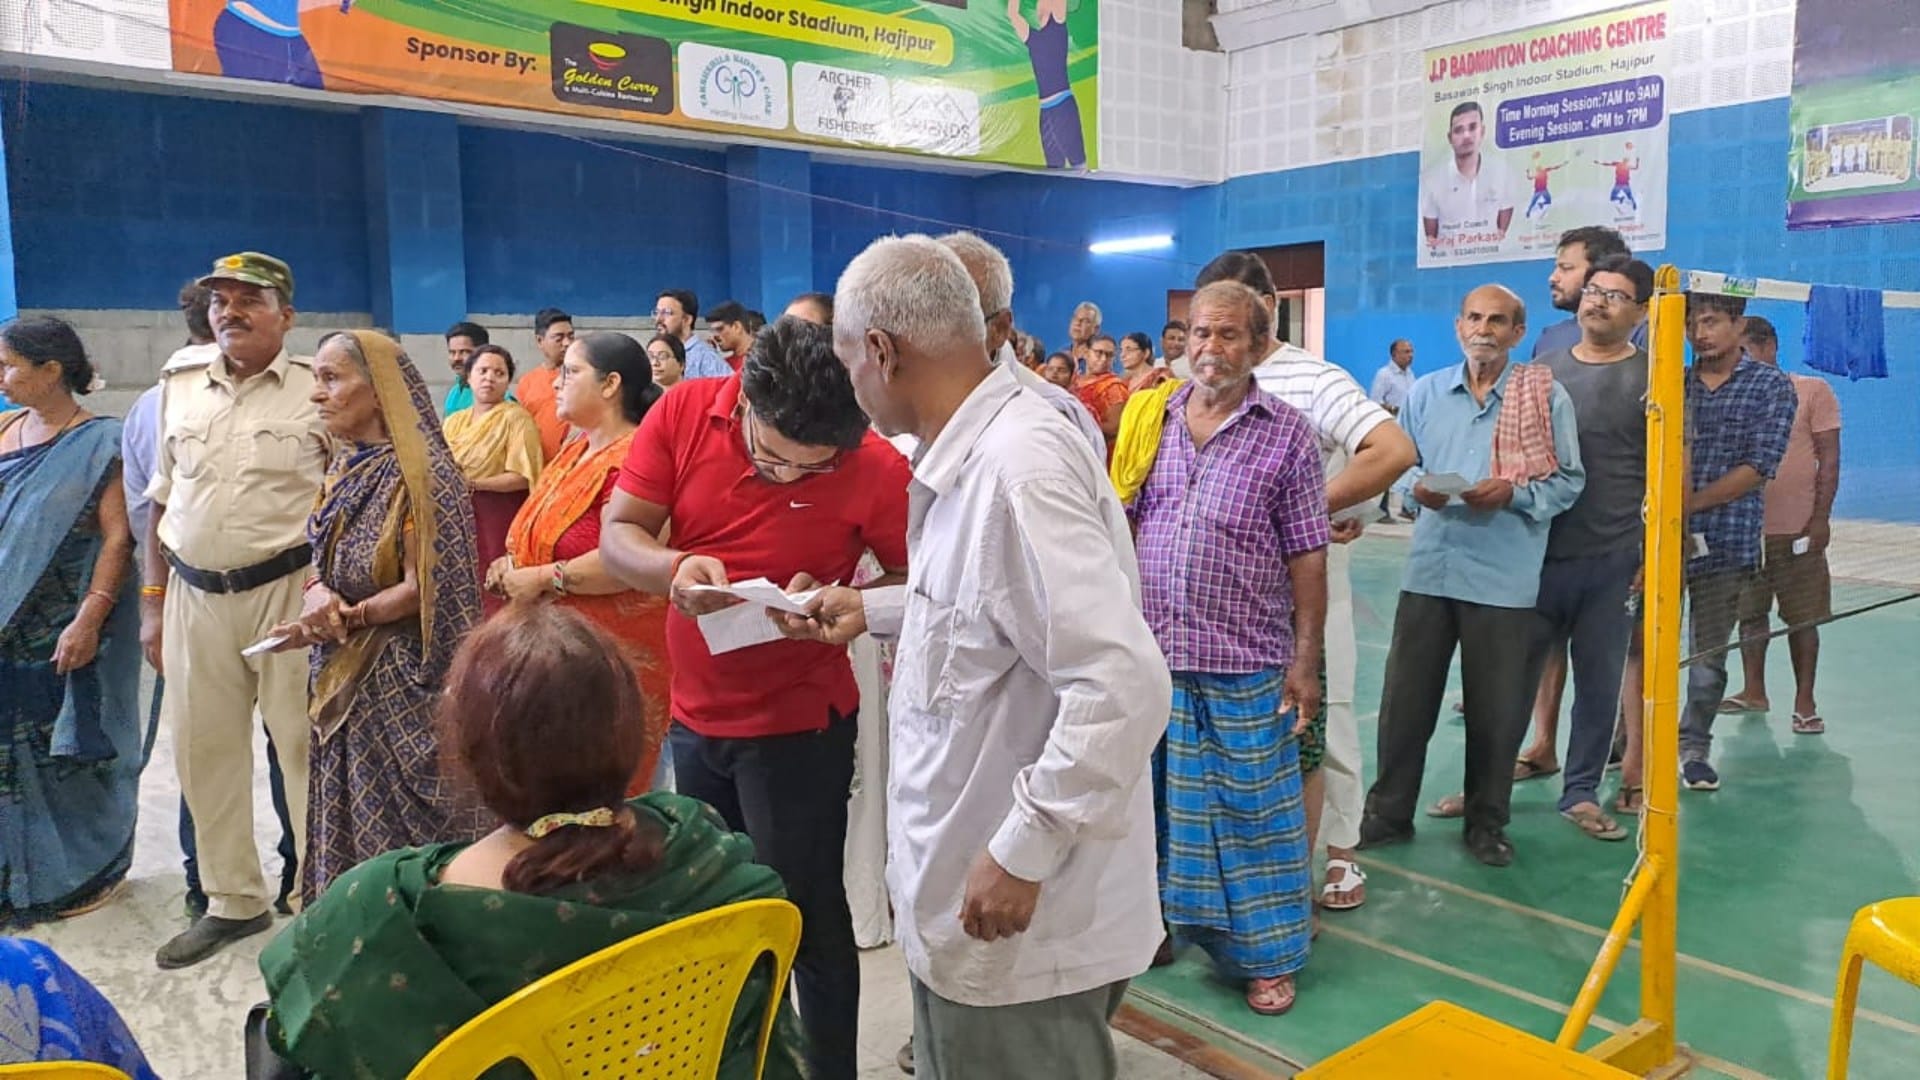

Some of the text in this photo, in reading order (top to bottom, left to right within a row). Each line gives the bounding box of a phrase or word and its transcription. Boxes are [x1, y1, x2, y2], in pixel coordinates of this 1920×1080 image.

[721, 0, 784, 23] Indoor
[788, 9, 869, 42] Stadium,
[874, 26, 936, 52] Hajipur
[407, 36, 537, 74] Sponsor By:
[564, 57, 578, 67] The
[1450, 42, 1526, 79] BADMINTON
[1530, 26, 1602, 63] COACHING
[1606, 12, 1667, 48] CENTRE
[563, 68, 660, 97] Golden Curry
[818, 70, 872, 90] ARCHER
[1483, 79, 1513, 94] Singh
[1516, 72, 1553, 88] Indoor
[1610, 54, 1656, 71] Hajipur
[1500, 107, 1522, 123] Time
[1523, 102, 1560, 119] Morning
[1625, 90, 1636, 103] to
[1637, 83, 1660, 101] 9AM
[818, 116, 876, 136] FISHERIES
[1509, 124, 1545, 142] Evening
[1546, 119, 1584, 137] Session
[1590, 112, 1612, 129] 4PM
[1613, 112, 1624, 126] to
[1626, 106, 1648, 124] 7PM
